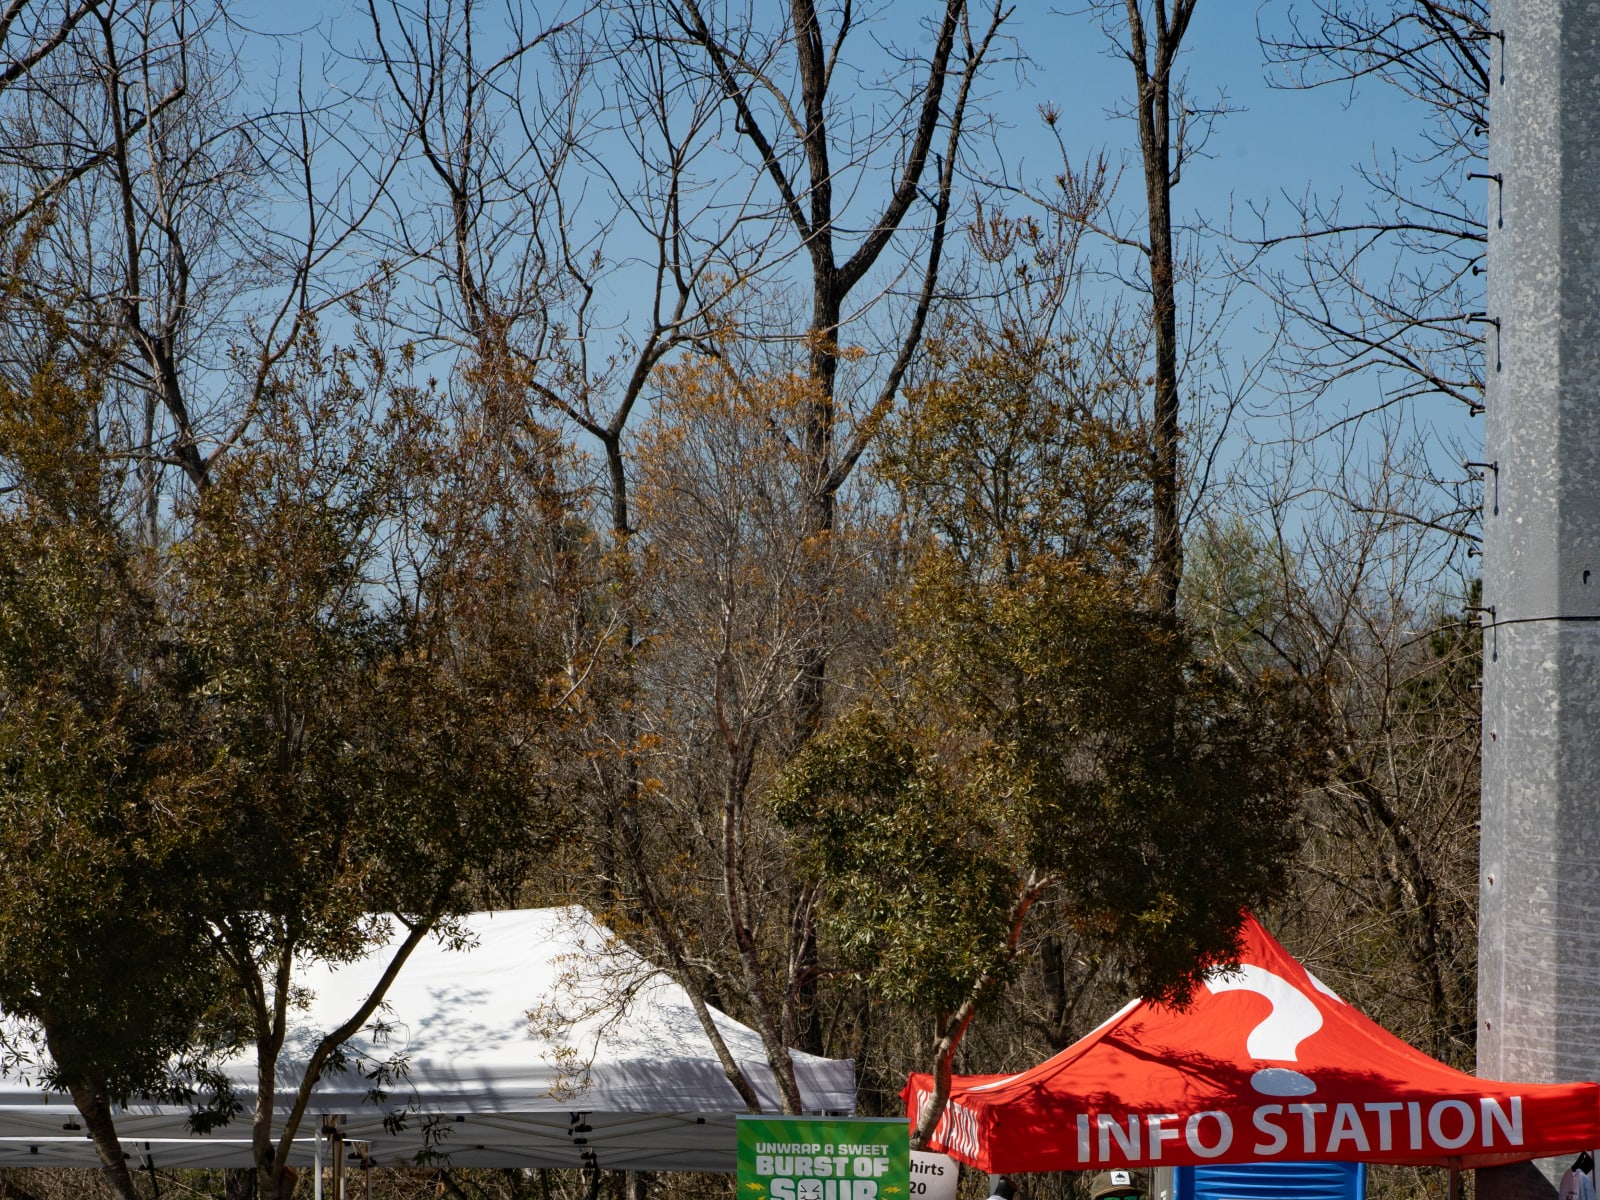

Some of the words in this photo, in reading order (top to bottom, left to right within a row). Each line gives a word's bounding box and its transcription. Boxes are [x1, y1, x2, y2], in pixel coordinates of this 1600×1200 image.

[1077, 1111, 1234, 1162] INFO
[1252, 1096, 1524, 1156] STATION
[756, 1142, 821, 1154] UNWRAP
[824, 1144, 834, 1155] A
[838, 1144, 889, 1156] SWEET
[756, 1156, 849, 1177] BURST
[853, 1157, 890, 1178] OF
